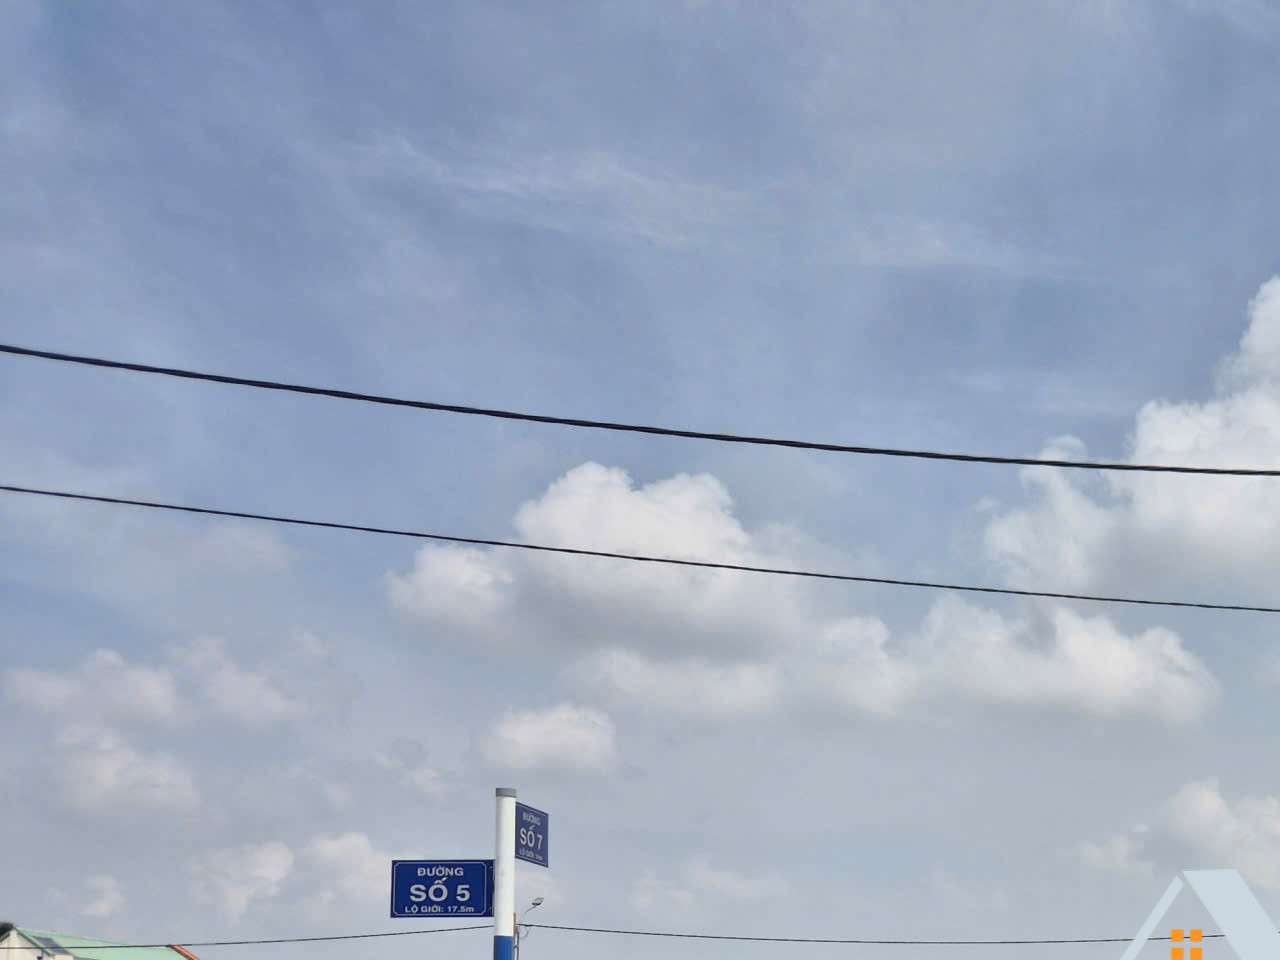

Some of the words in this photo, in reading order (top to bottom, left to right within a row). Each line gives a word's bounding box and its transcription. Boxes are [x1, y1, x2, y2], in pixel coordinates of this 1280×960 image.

[520, 825, 535, 848] SỐ
[537, 834, 543, 850] 7
[417, 866, 464, 876] ĐƯỜNG
[409, 877, 448, 902] SỐ
[456, 885, 471, 901] 5
[405, 905, 418, 914] LỘ
[448, 905, 474, 913] 17.5m
